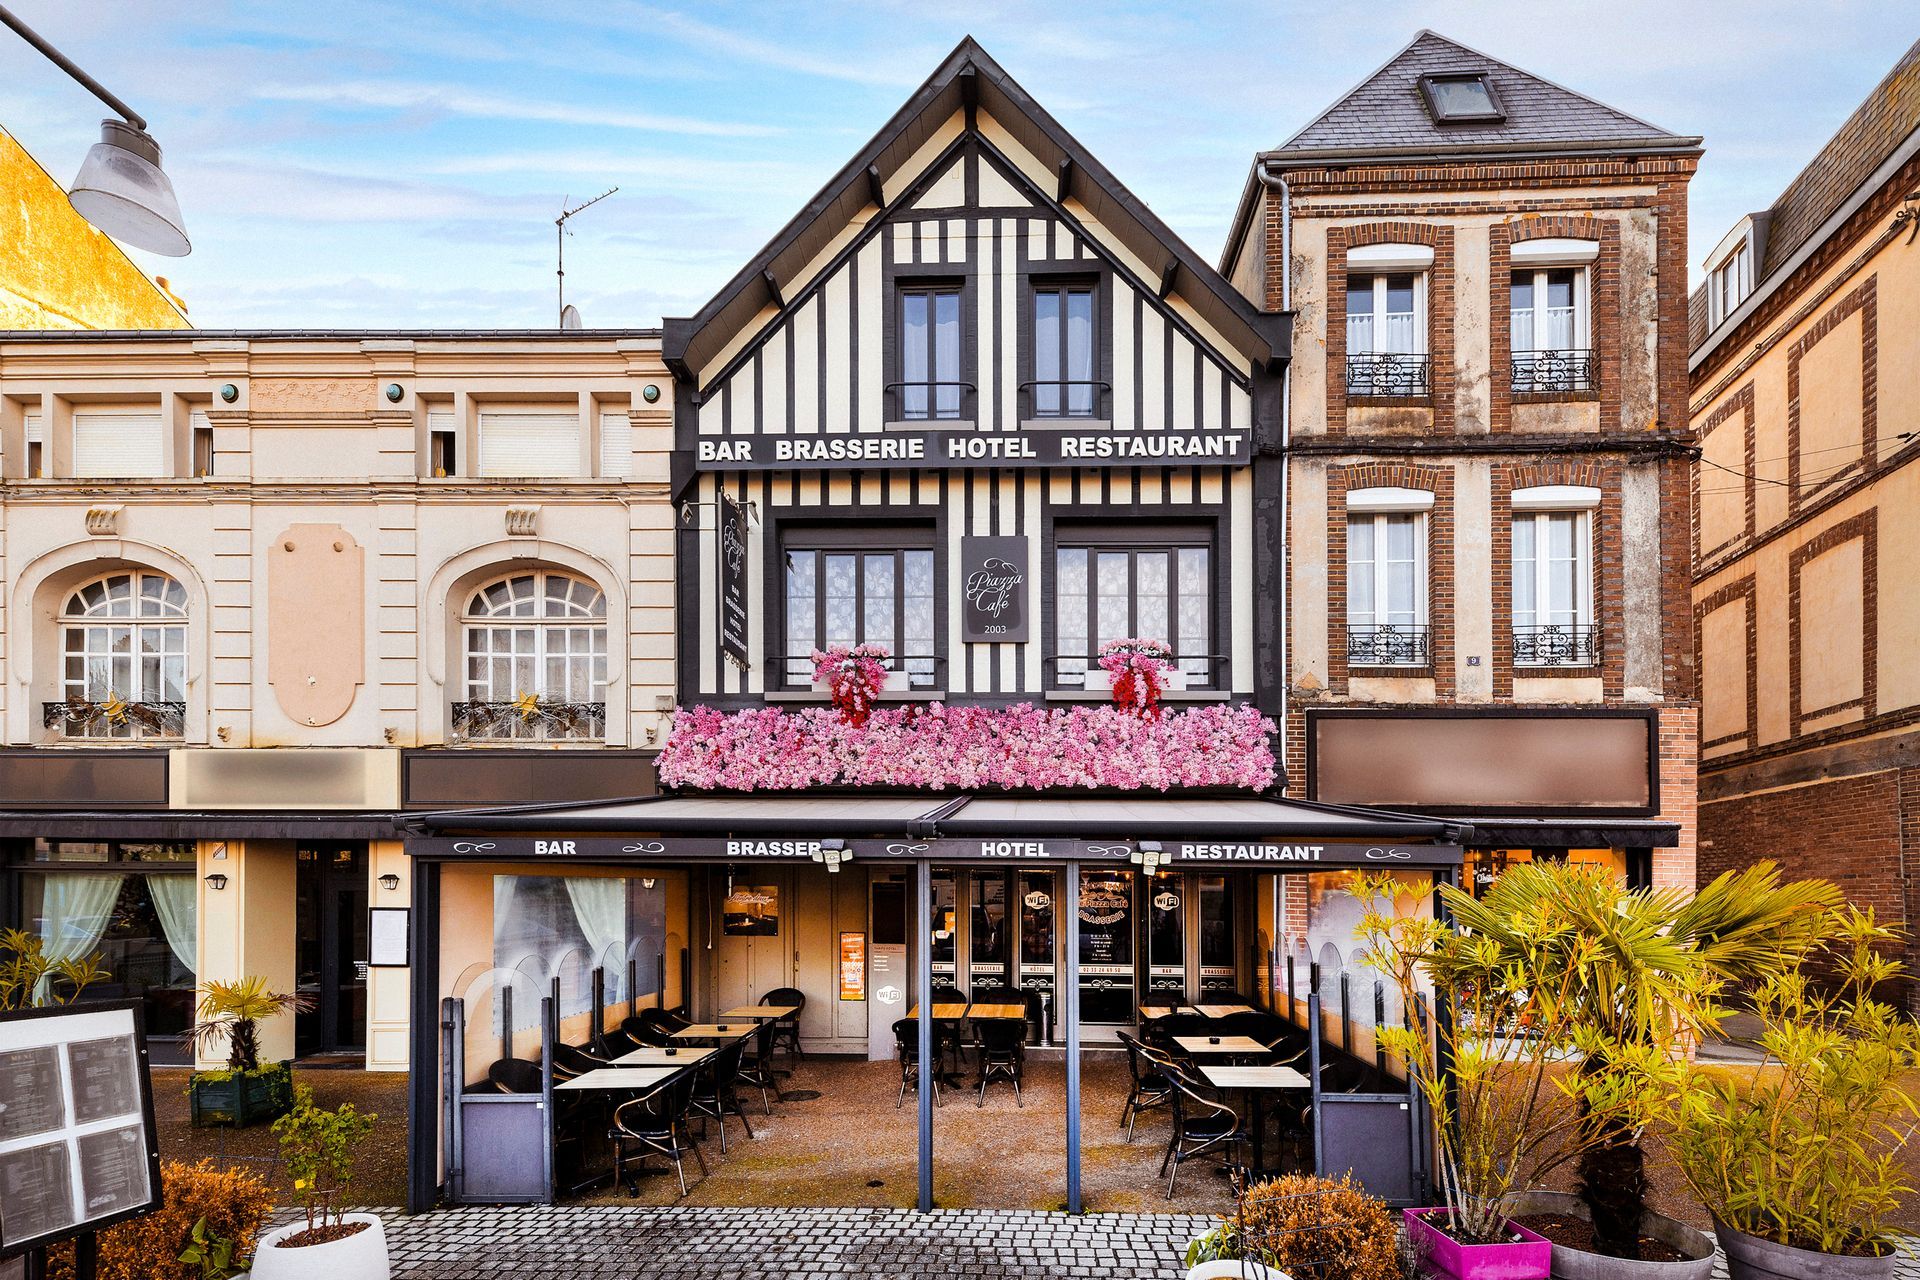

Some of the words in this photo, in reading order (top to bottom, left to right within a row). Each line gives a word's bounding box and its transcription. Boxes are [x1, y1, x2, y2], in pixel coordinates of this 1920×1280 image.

[699, 440, 753, 462] BAR
[775, 438, 925, 461] BRASSERIE
[948, 437, 1037, 459] HOTEL
[1061, 435, 1243, 458] RESTAURANT
[731, 584, 740, 598] BAR
[966, 570, 1024, 593] Piazza
[967, 587, 1010, 619] Café
[724, 628, 748, 653] RESTAURANT
[984, 625, 1007, 634] 2003
[534, 840, 577, 855] BAR
[1181, 844, 1324, 861] RESTAURANT
